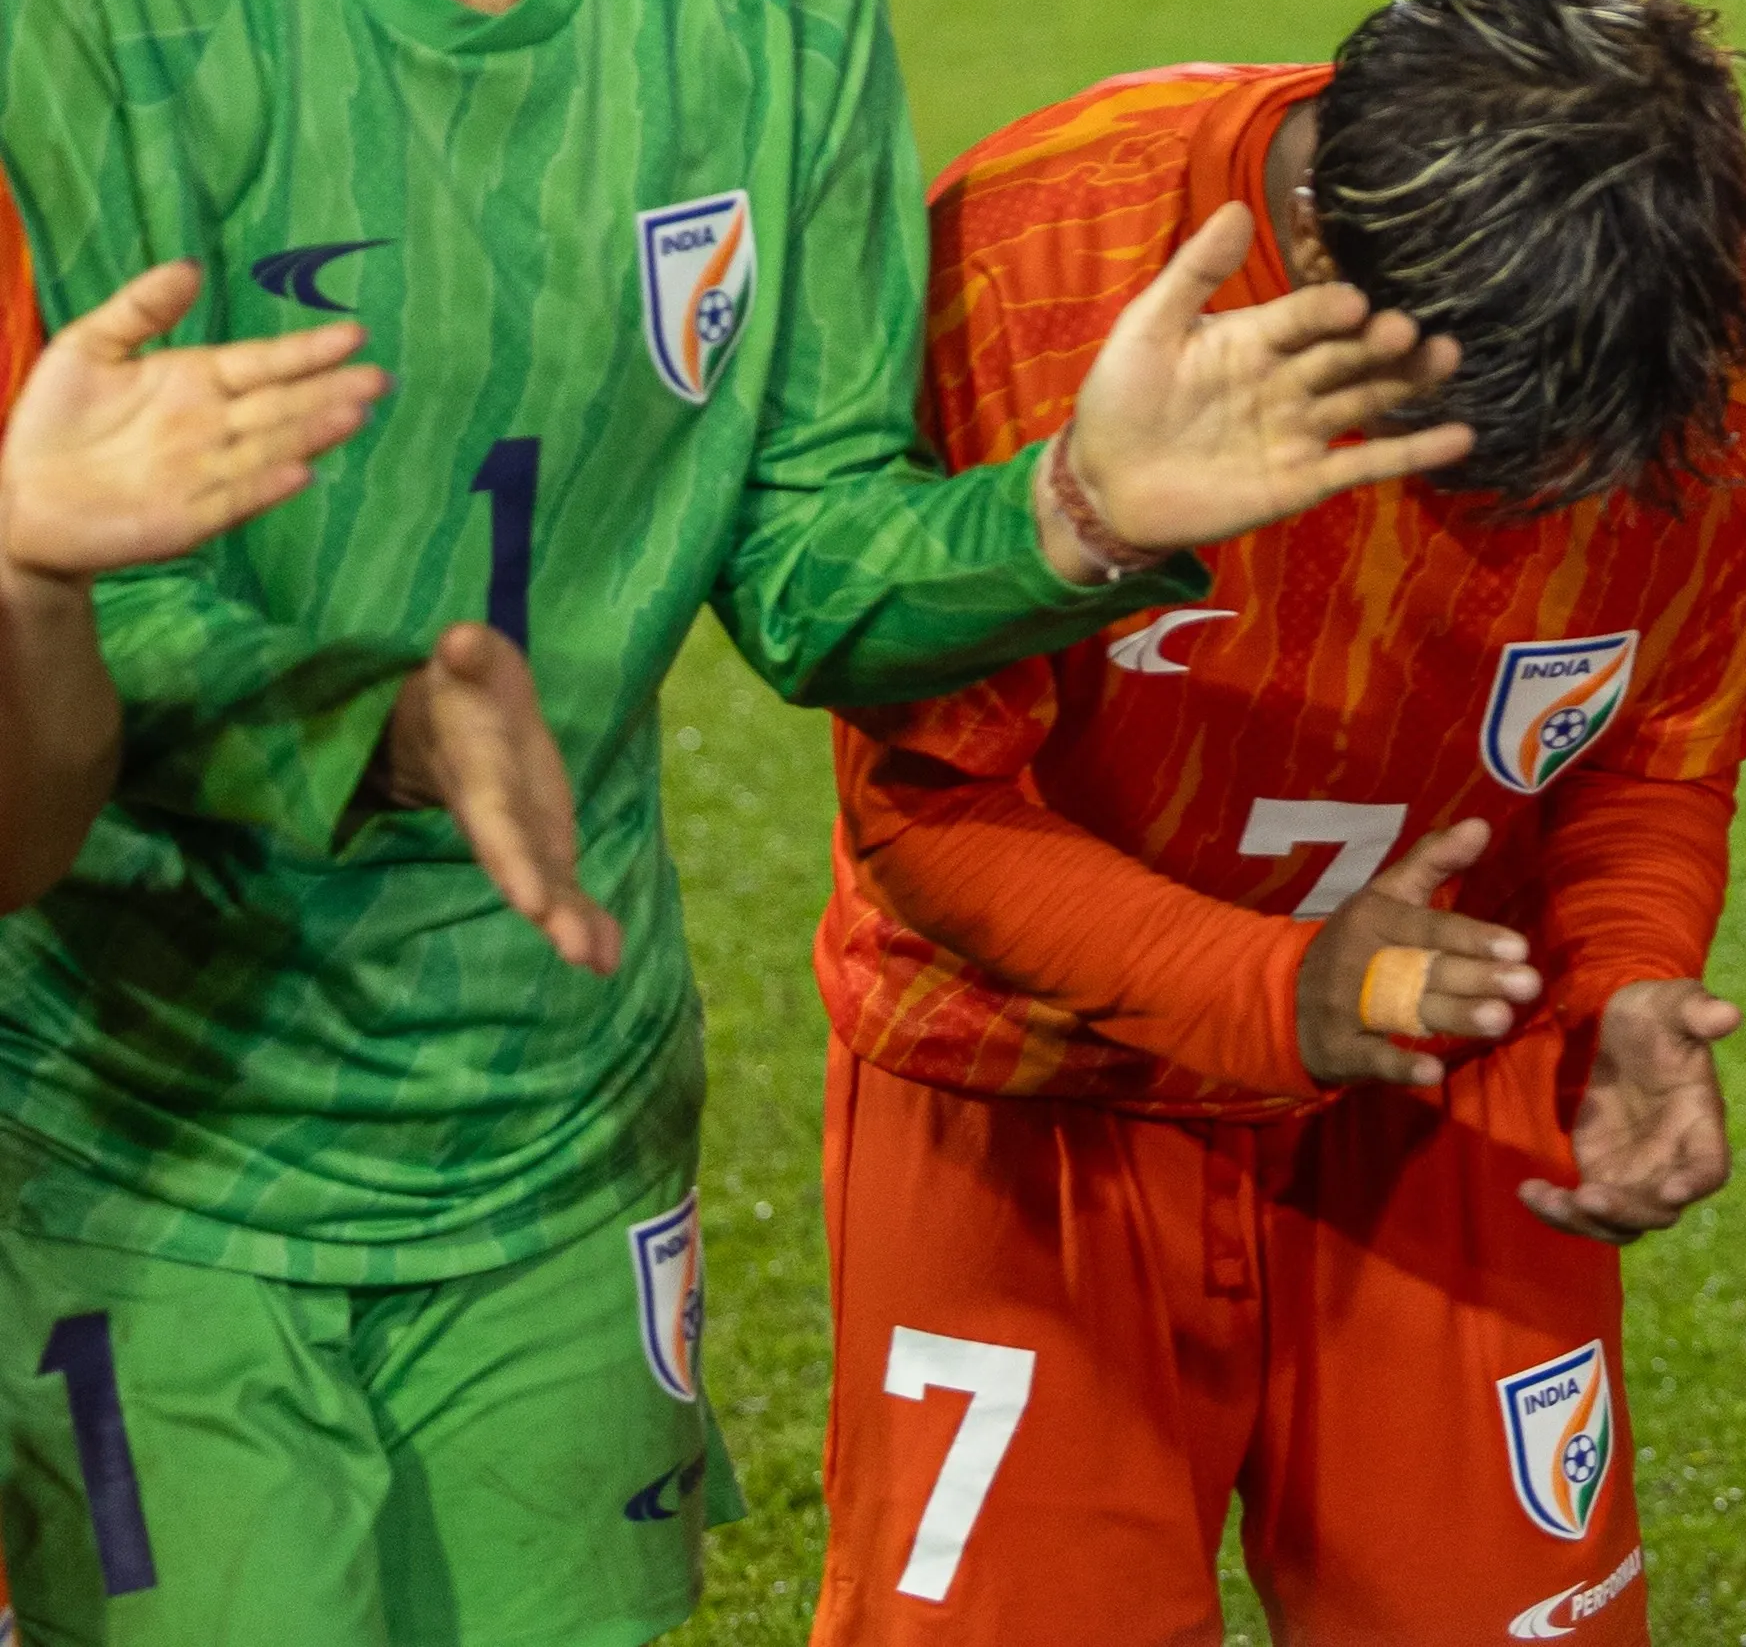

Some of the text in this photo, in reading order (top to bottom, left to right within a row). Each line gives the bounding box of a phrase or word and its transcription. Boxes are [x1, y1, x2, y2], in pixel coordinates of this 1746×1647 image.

[661, 225, 717, 257] INDIA
[469, 437, 542, 653] 1
[1520, 657, 1591, 680] INDIA
[1238, 798, 1409, 921] 7
[38, 1310, 157, 1598] 1
[1523, 1377, 1581, 1415] INDIA
[884, 1325, 1037, 1602] 7
